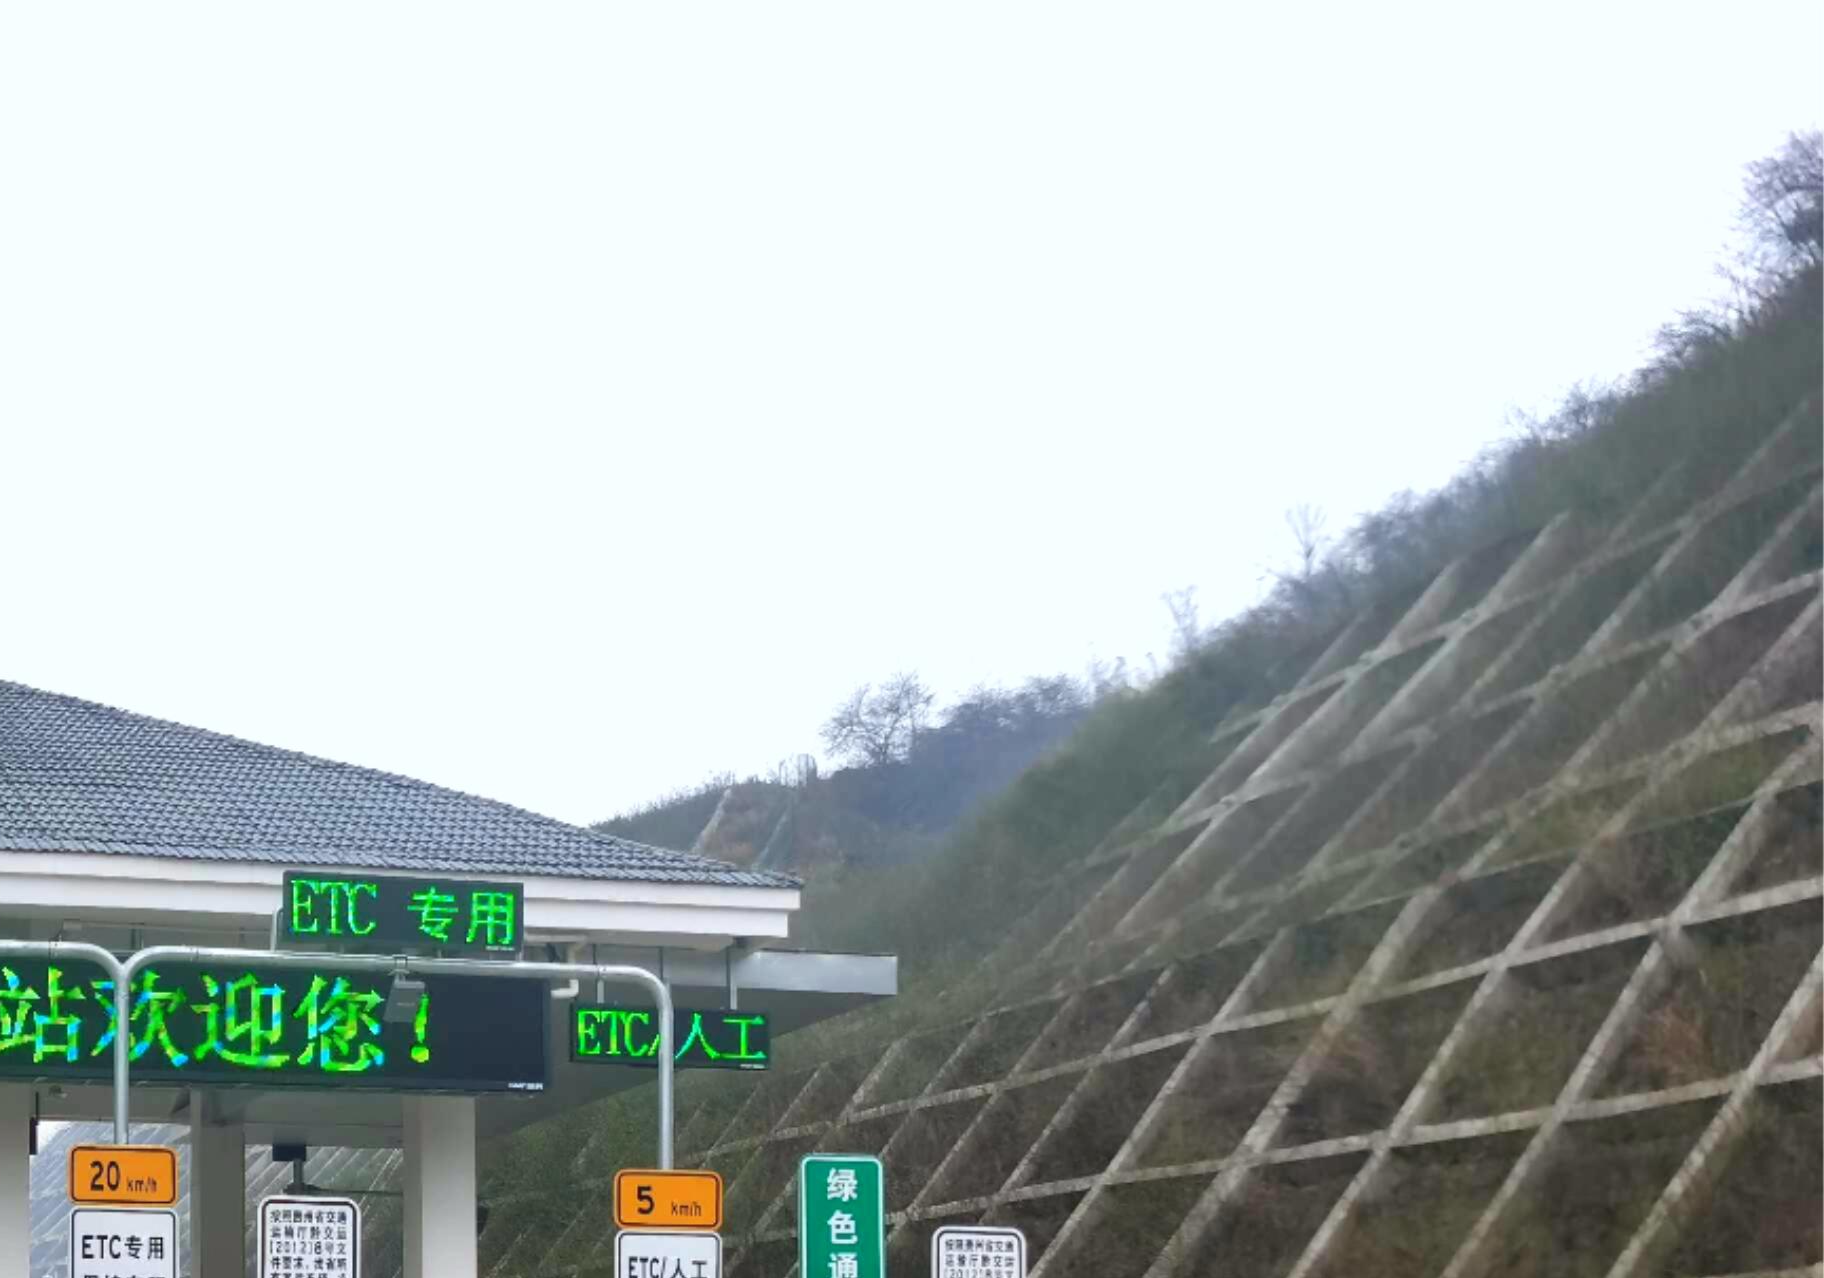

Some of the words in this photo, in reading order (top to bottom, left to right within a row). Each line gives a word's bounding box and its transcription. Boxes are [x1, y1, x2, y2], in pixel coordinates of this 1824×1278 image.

[291, 880, 376, 936] ETC
[407, 885, 515, 946] 专用
[90, 1161, 120, 1191] 20
[126, 1176, 157, 1193] km/h
[636, 1185, 655, 1215] 5
[671, 1201, 702, 1218] km/h
[81, 1235, 164, 1260] ETC专用
